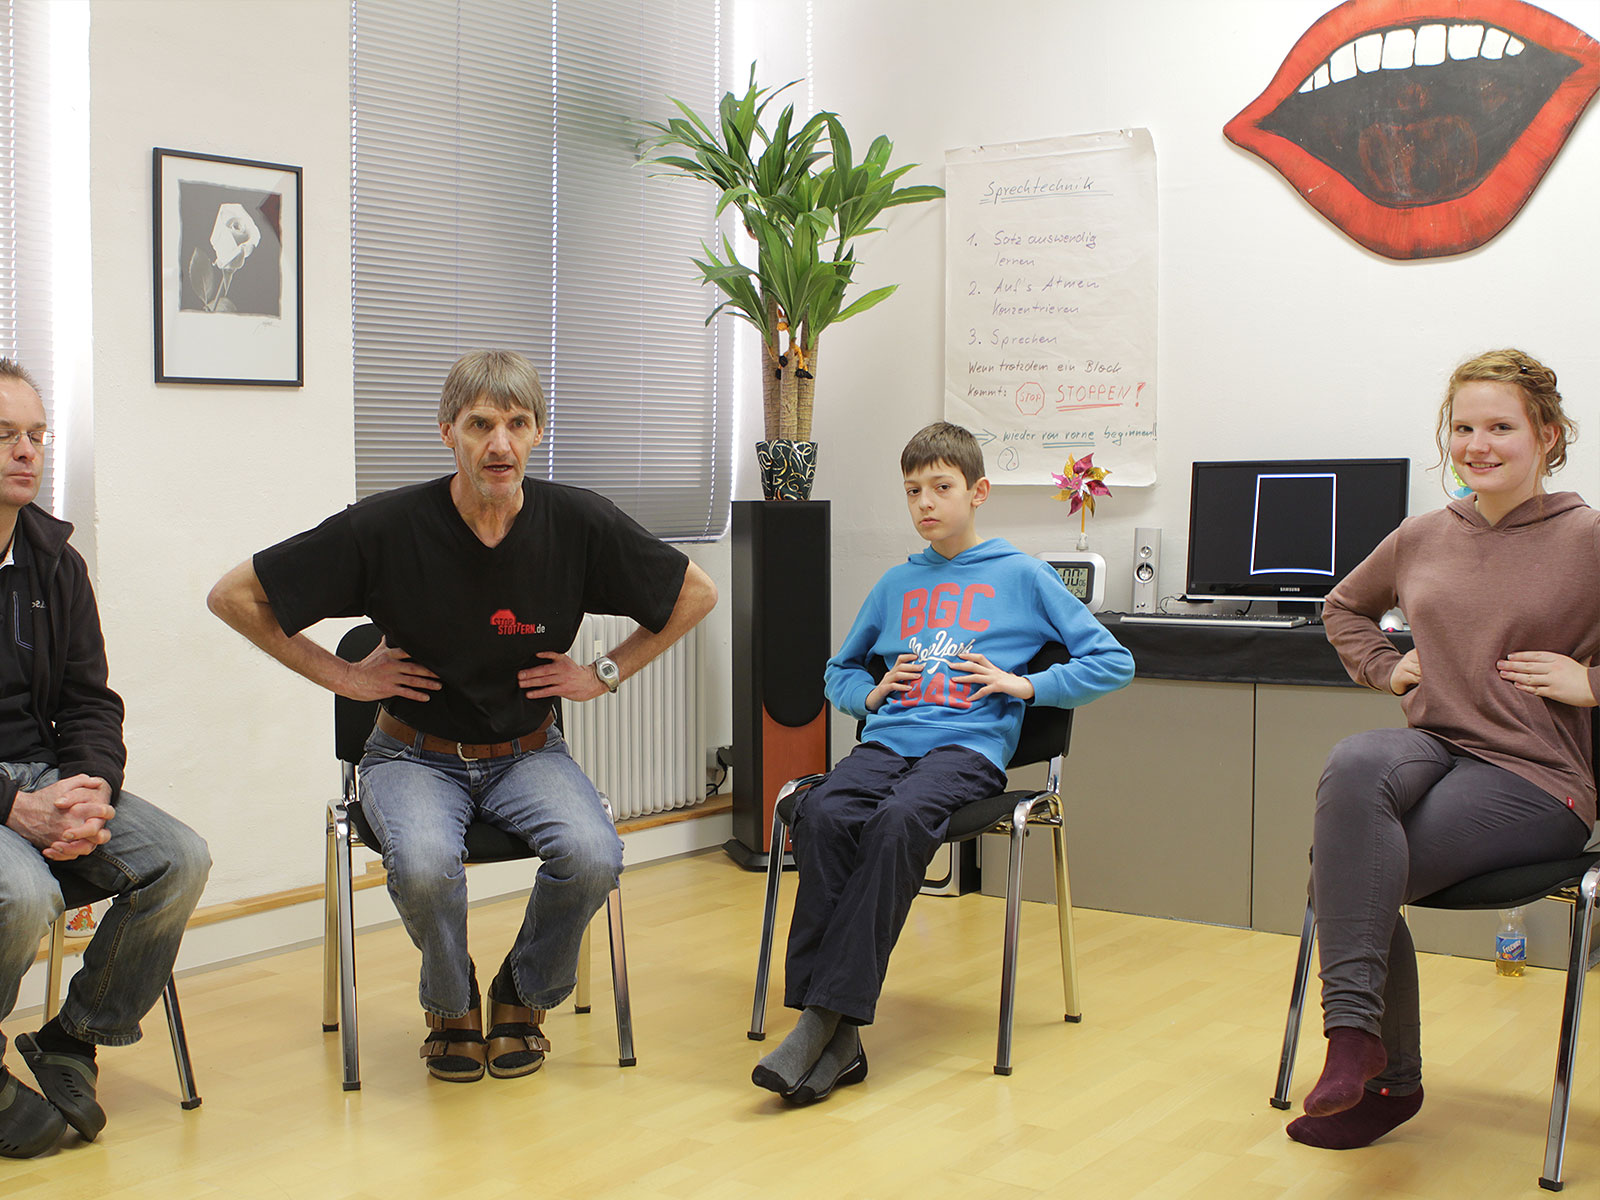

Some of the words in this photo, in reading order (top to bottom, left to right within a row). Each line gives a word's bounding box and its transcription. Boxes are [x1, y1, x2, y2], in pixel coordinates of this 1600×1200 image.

[983, 176, 1096, 205] Sprechtechnik
[966, 232, 978, 247] 1.
[993, 230, 1022, 246] Satz
[994, 251, 1035, 267] lernen
[968, 280, 981, 296] 2.
[993, 277, 1032, 295] Auf's
[1041, 274, 1100, 292] Atmen
[968, 328, 982, 346] 3.
[991, 328, 1058, 349] Sprechen
[968, 361, 995, 374] Wenn
[1000, 358, 1049, 372] trotzdem
[1057, 360, 1076, 372] ein
[1084, 360, 1122, 373] Block
[1019, 391, 1042, 403] STOP
[1002, 429, 1036, 443] wieder
[1065, 430, 1096, 441] vorne
[901, 582, 996, 641] BGC
